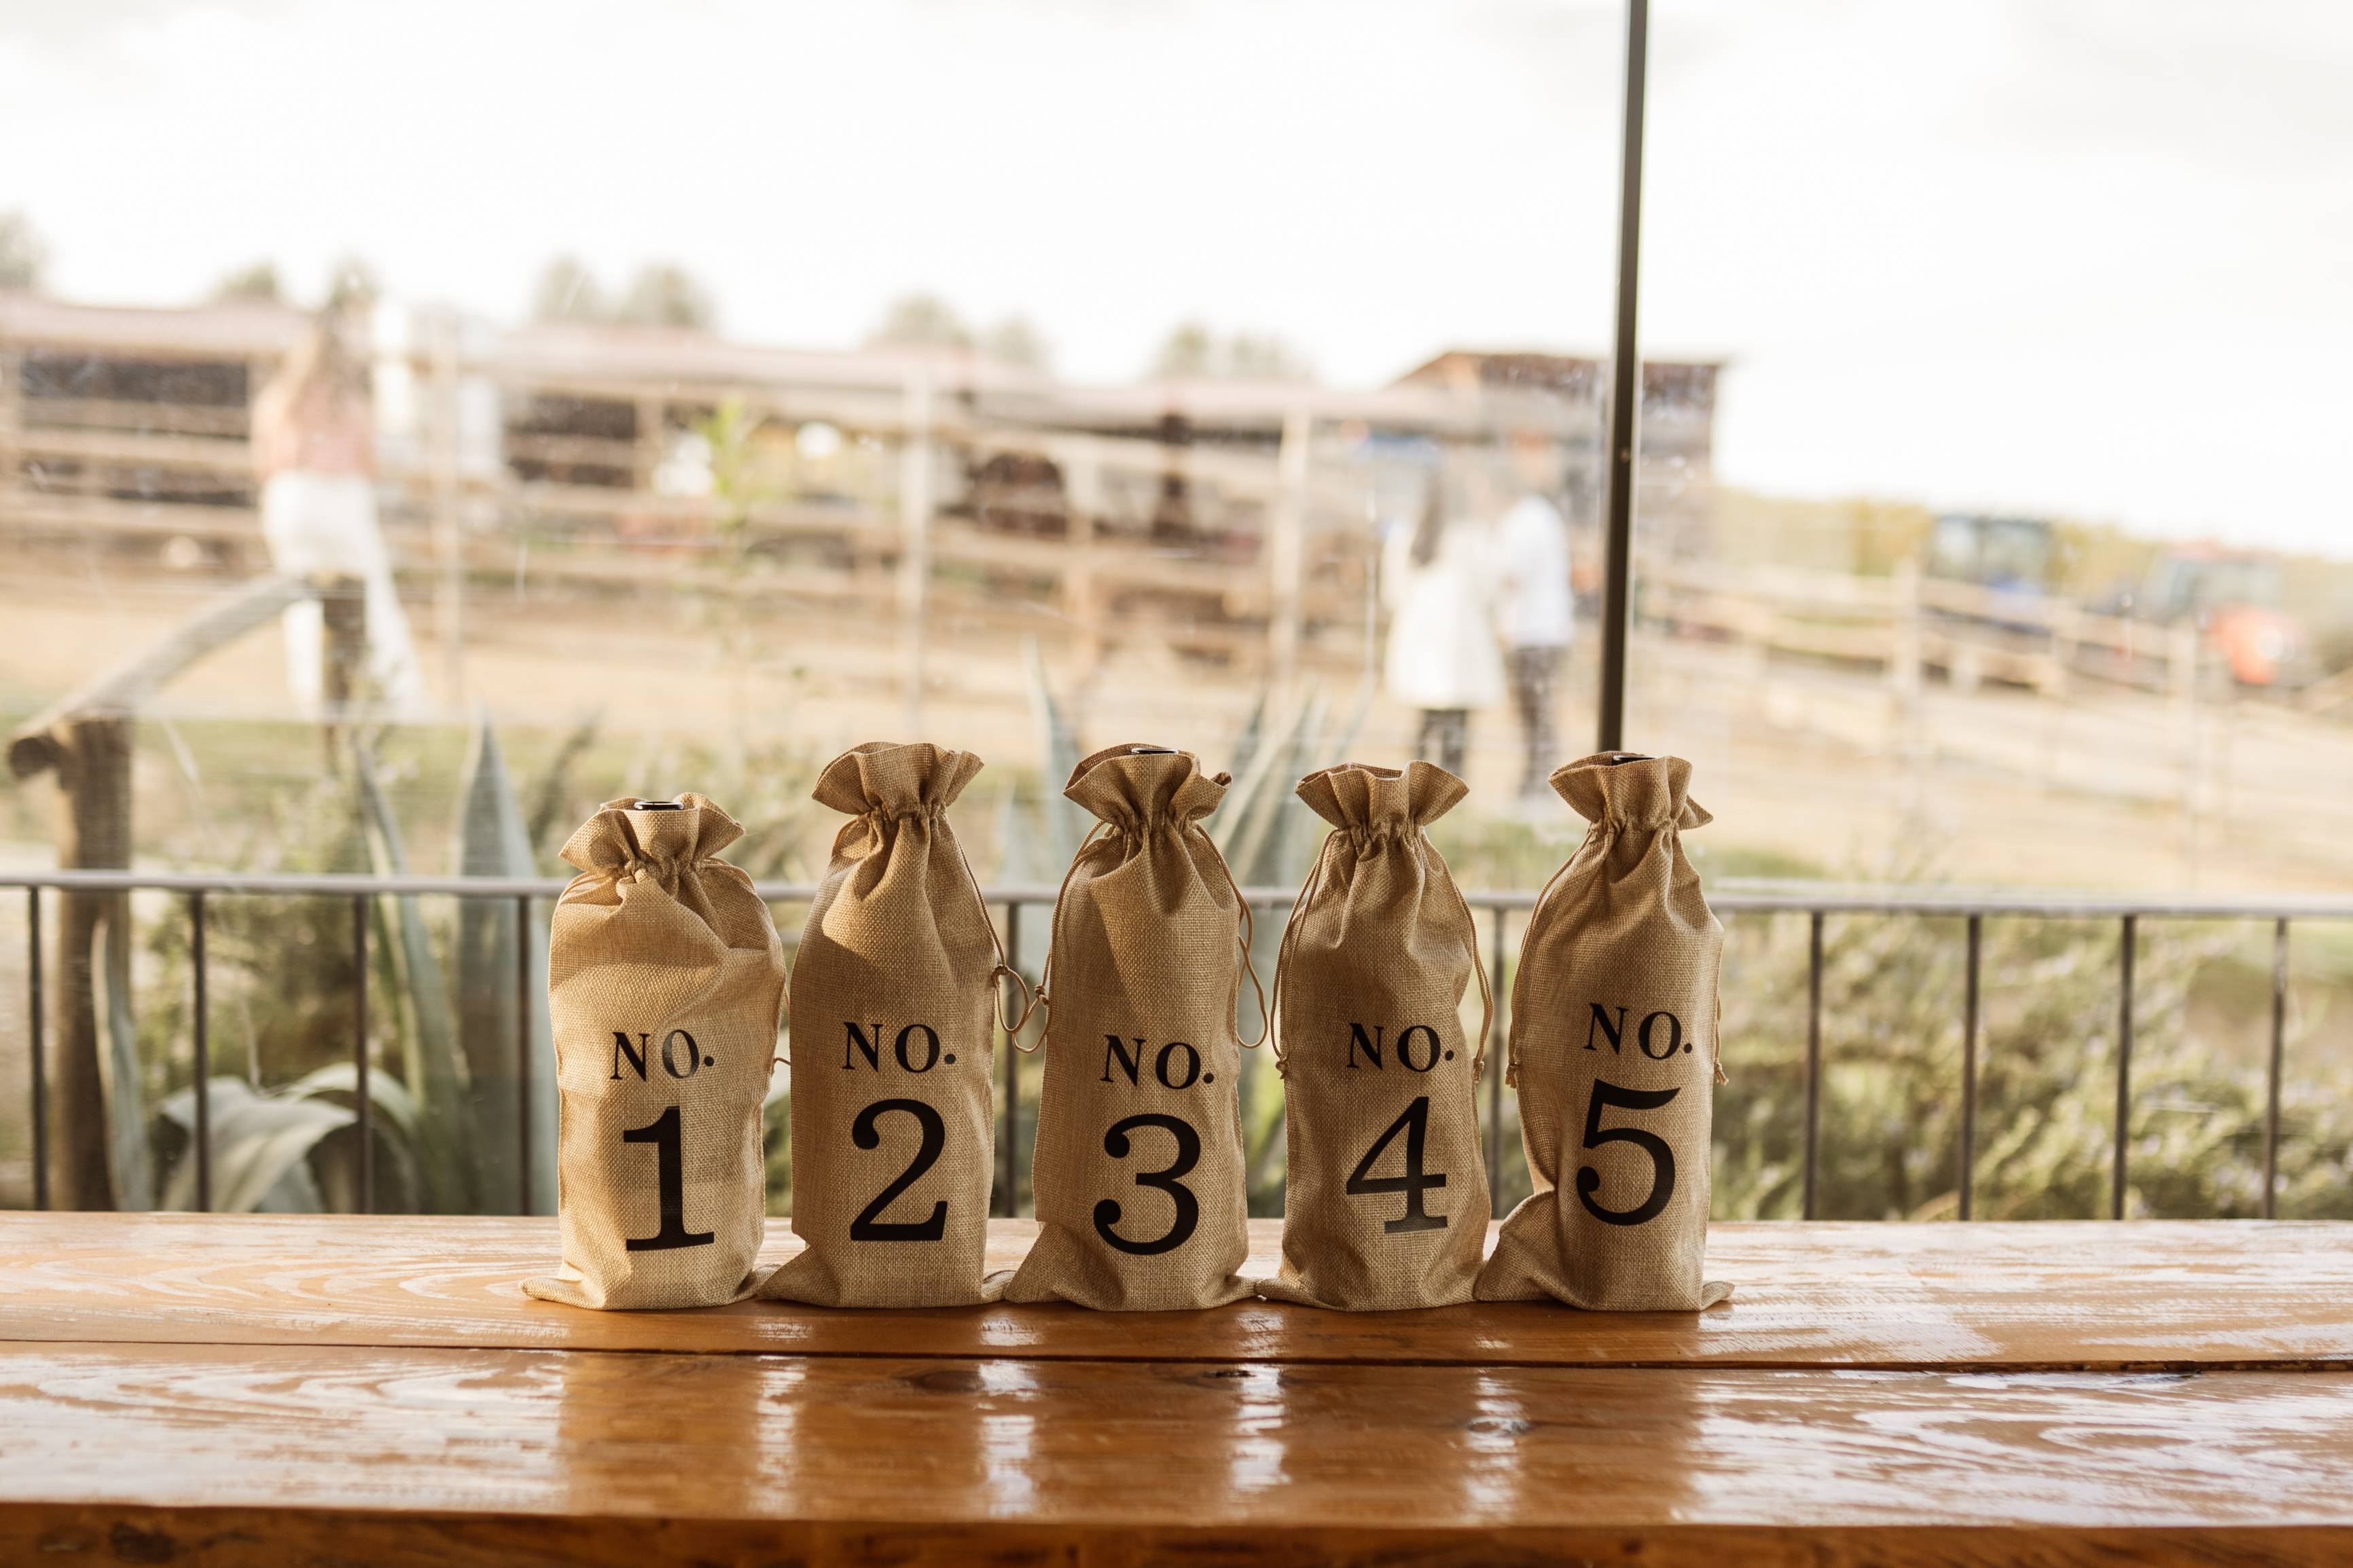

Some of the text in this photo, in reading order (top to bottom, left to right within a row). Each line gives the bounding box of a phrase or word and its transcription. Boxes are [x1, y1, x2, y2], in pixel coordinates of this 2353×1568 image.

[611, 1029, 715, 1081] NO.
[842, 1021, 956, 1073] NO.
[1100, 1034, 1214, 1089] NO.
[1346, 1023, 1454, 1074] NO.
[1583, 1003, 1693, 1059] NO.
[623, 1106, 714, 1251] 1
[850, 1099, 948, 1241] 2
[1093, 1114, 1200, 1256] 3
[1346, 1097, 1447, 1233] 4
[1575, 1078, 1679, 1226] 5
